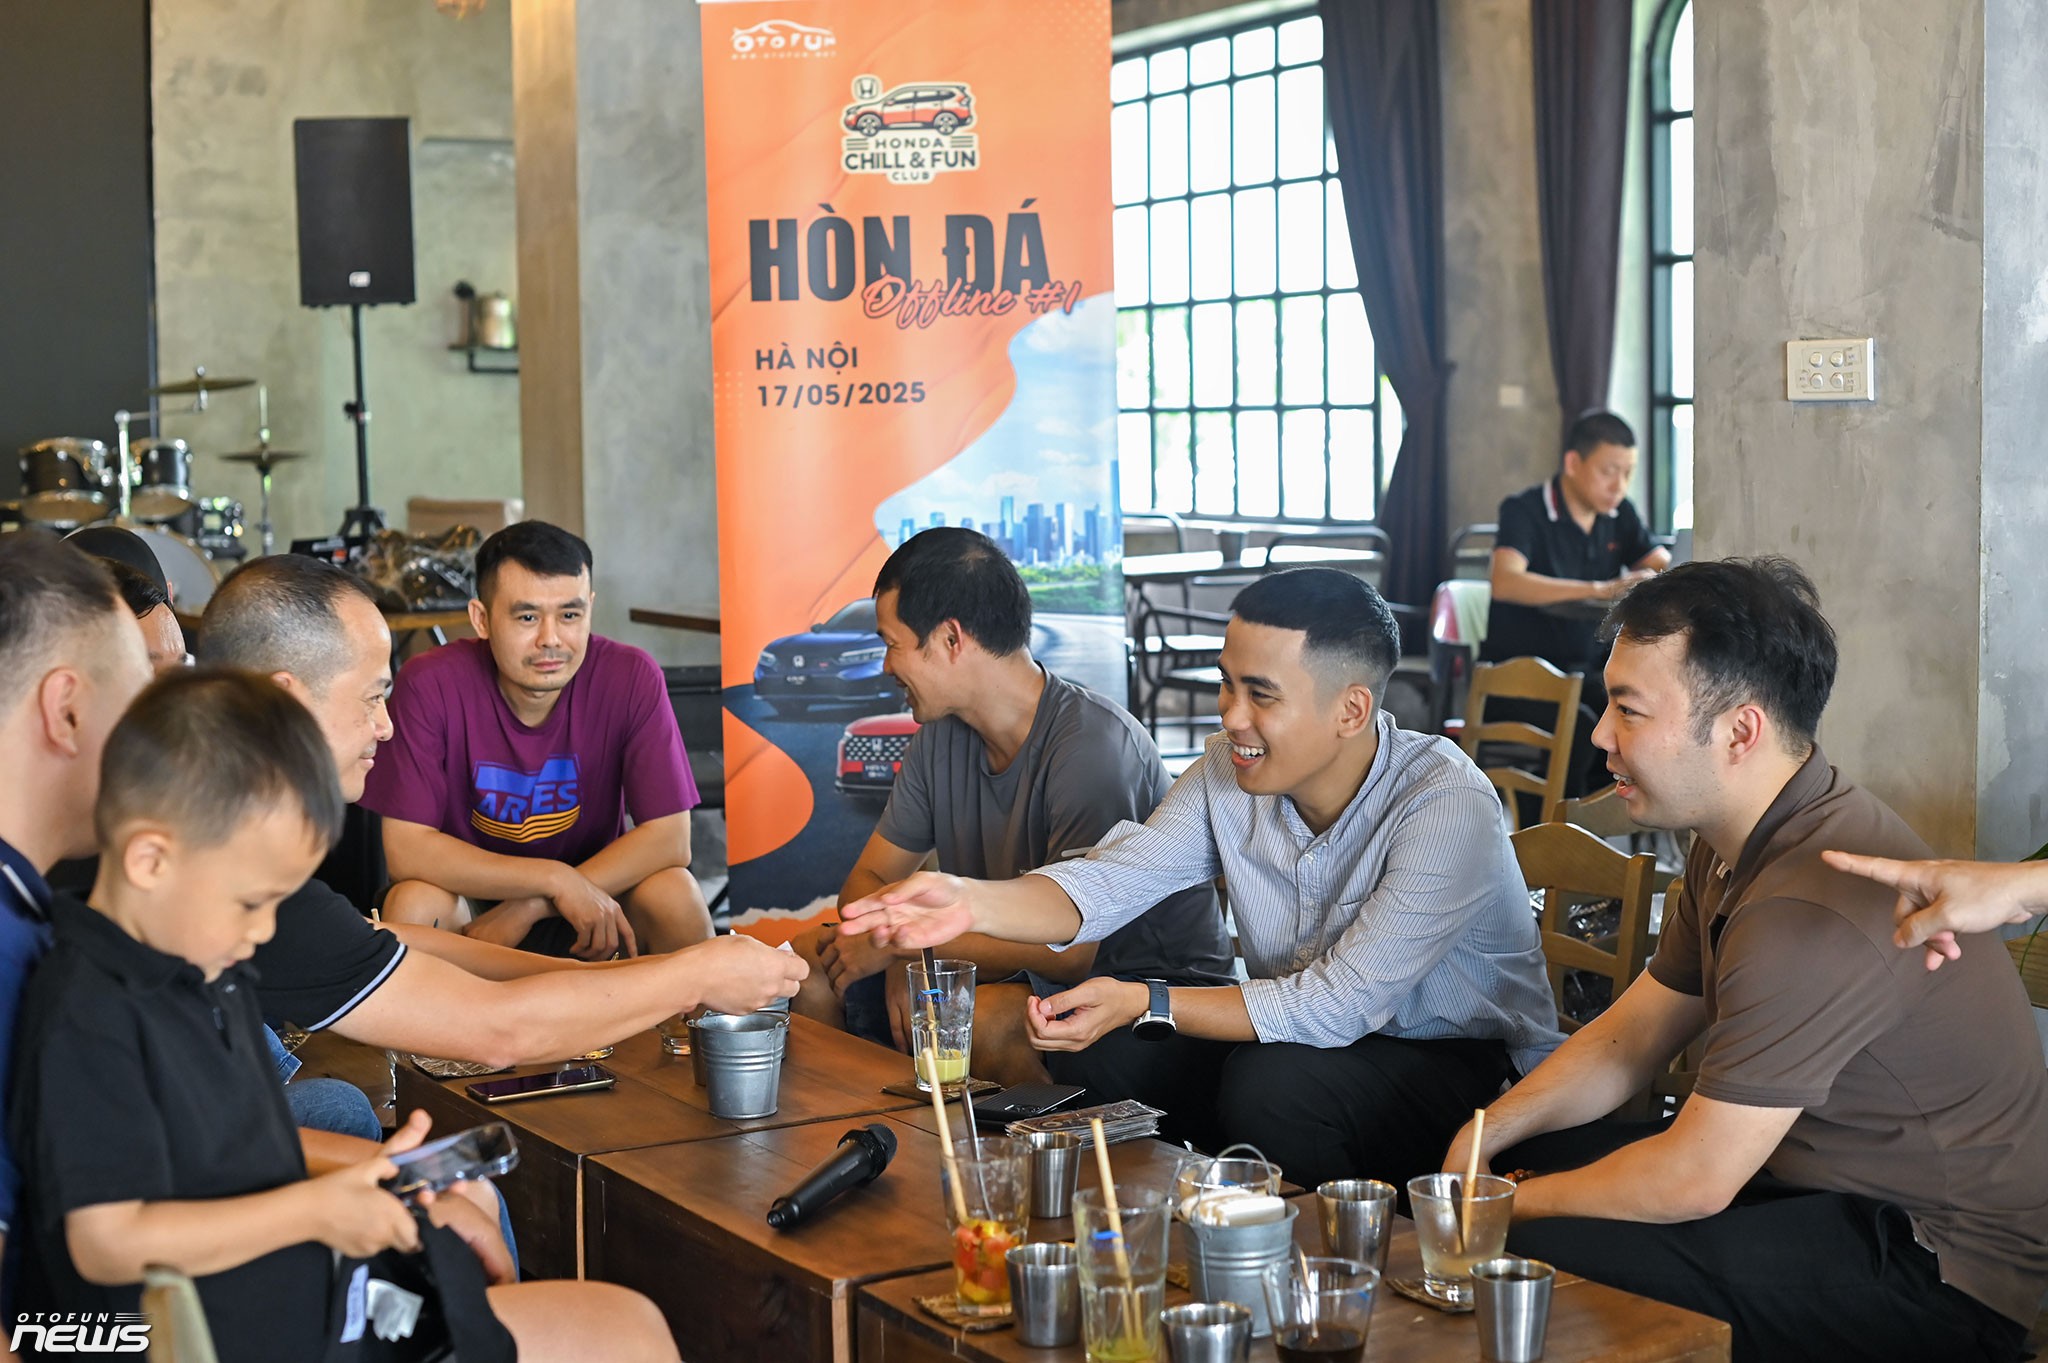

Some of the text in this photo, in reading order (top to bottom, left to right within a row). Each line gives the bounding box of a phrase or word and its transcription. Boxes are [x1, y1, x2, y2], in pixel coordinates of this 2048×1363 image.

[875, 137, 944, 149] HONDA
[845, 149, 976, 170] CHILL & FUN
[892, 170, 930, 181] CLUB
[749, 198, 1050, 302] HÒN ĐÁ
[861, 274, 1017, 330] Offline
[756, 340, 858, 375] HÀ NỘI
[758, 381, 926, 409] 17/05/2025
[478, 782, 578, 824] ARES
